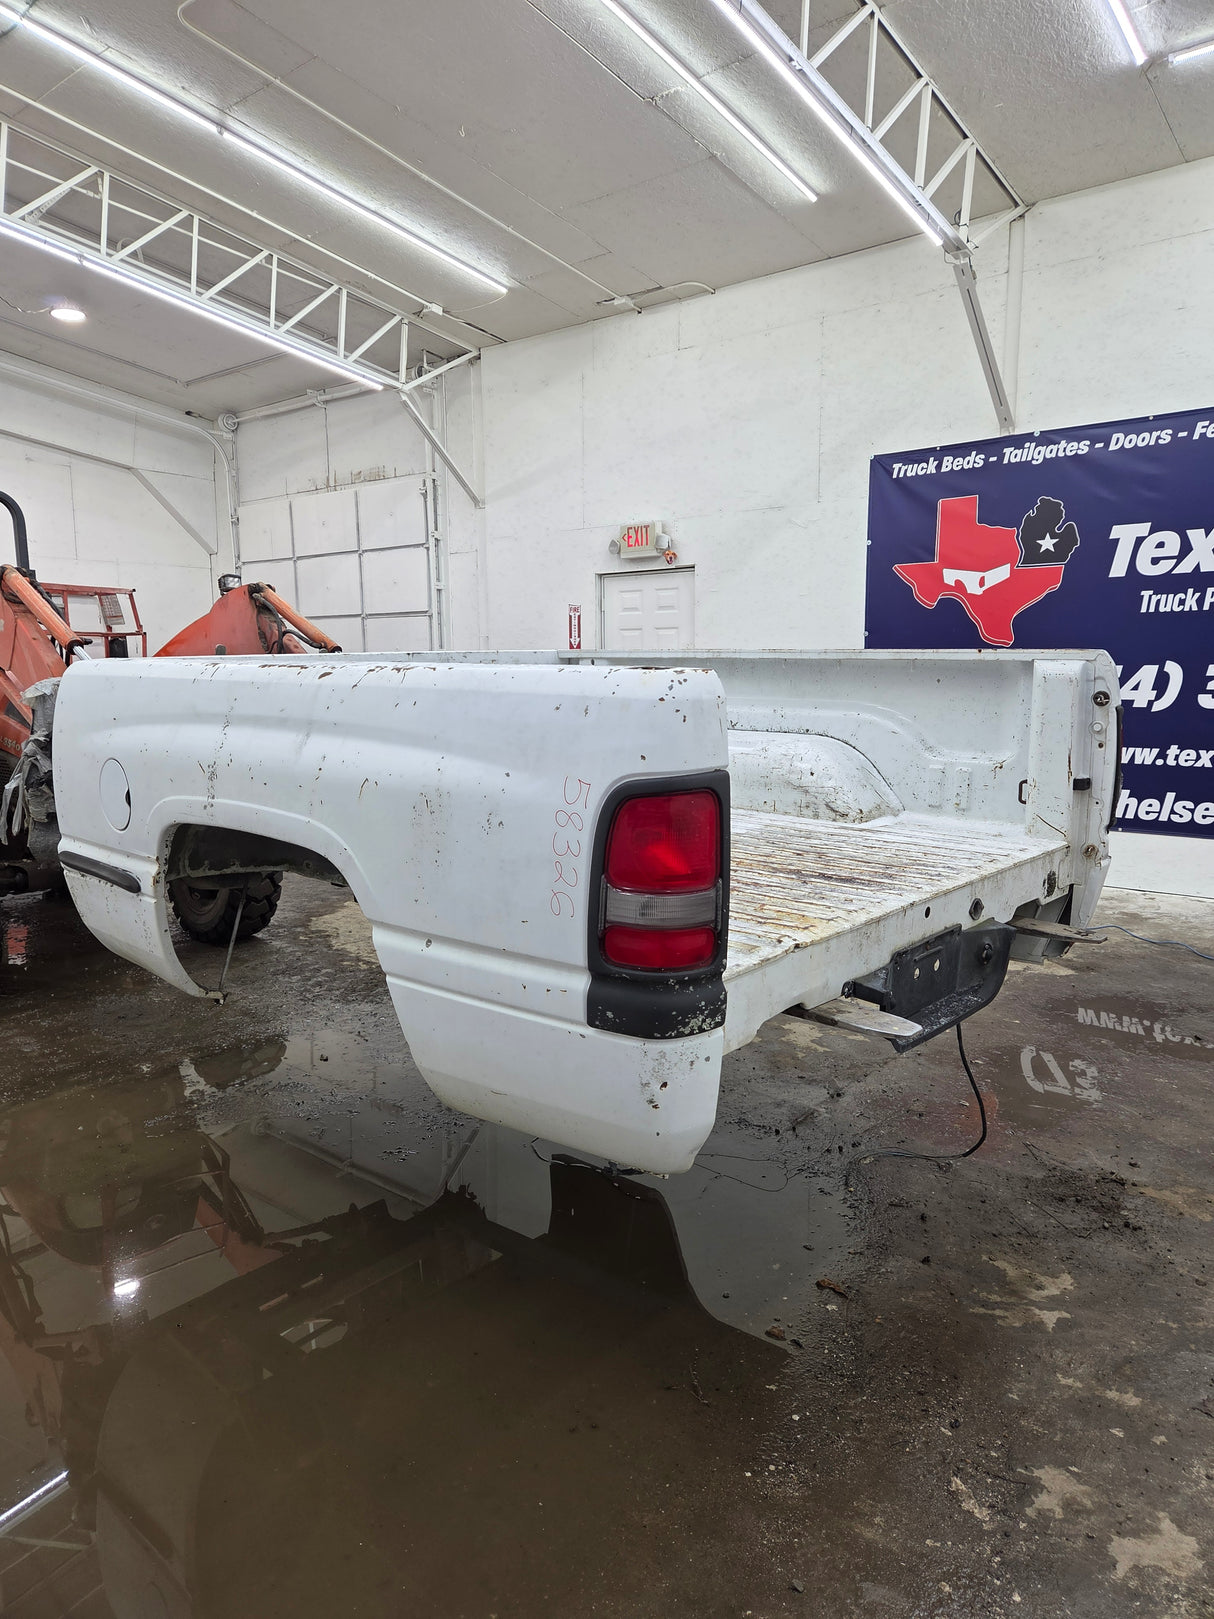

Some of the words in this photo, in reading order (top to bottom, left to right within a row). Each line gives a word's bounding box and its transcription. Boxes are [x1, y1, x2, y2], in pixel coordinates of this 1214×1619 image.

[892, 457, 938, 479] Truck
[941, 451, 985, 473] Beds
[1002, 439, 1090, 465] Tailgates
[1108, 429, 1173, 451] Doors
[627, 525, 650, 547] EXIT
[1108, 522, 1214, 578] Tex
[1140, 588, 1201, 613] Truck
[1115, 660, 1184, 712] 4)
[1115, 789, 1214, 825] helse
[550, 776, 591, 918] 58326
